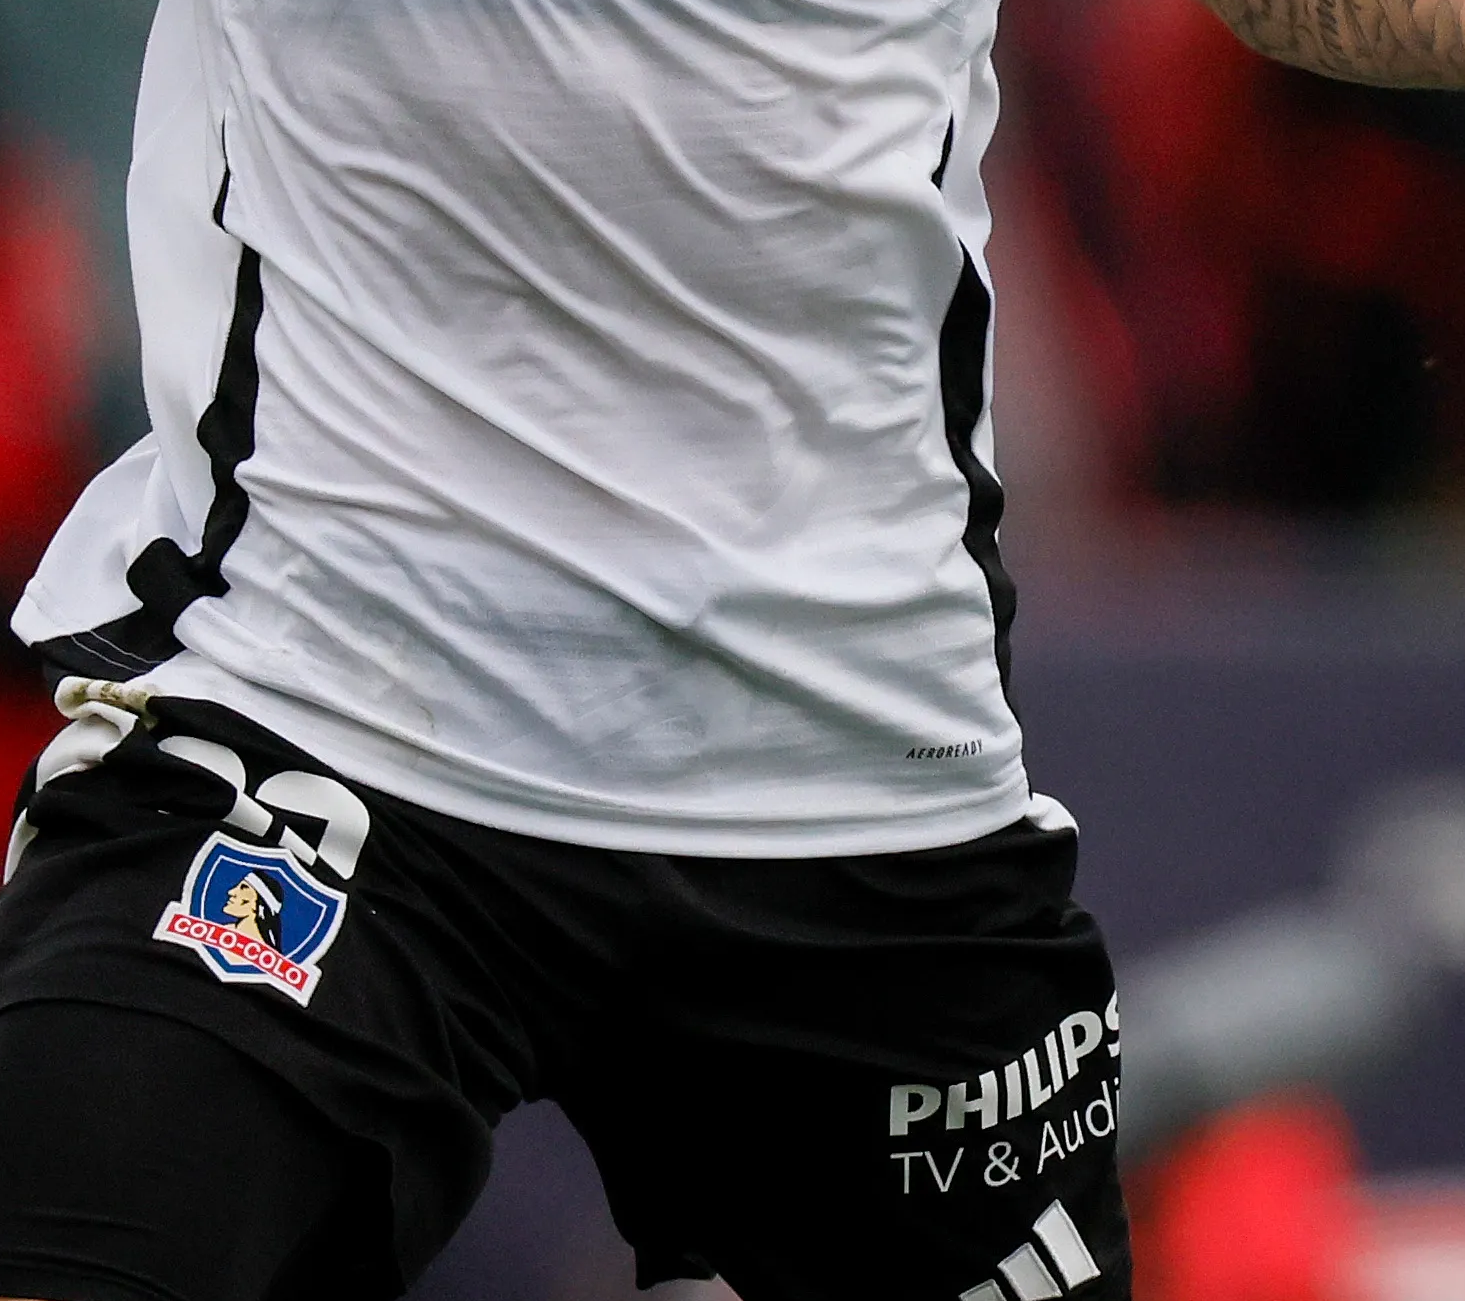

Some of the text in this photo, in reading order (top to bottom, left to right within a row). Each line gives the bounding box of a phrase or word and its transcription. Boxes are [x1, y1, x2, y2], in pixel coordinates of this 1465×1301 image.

[906, 739, 983, 759] AEROREADY
[173, 916, 303, 987] COLO-COLO
[890, 1146, 965, 1194] TV
[983, 1141, 1021, 1187] &
